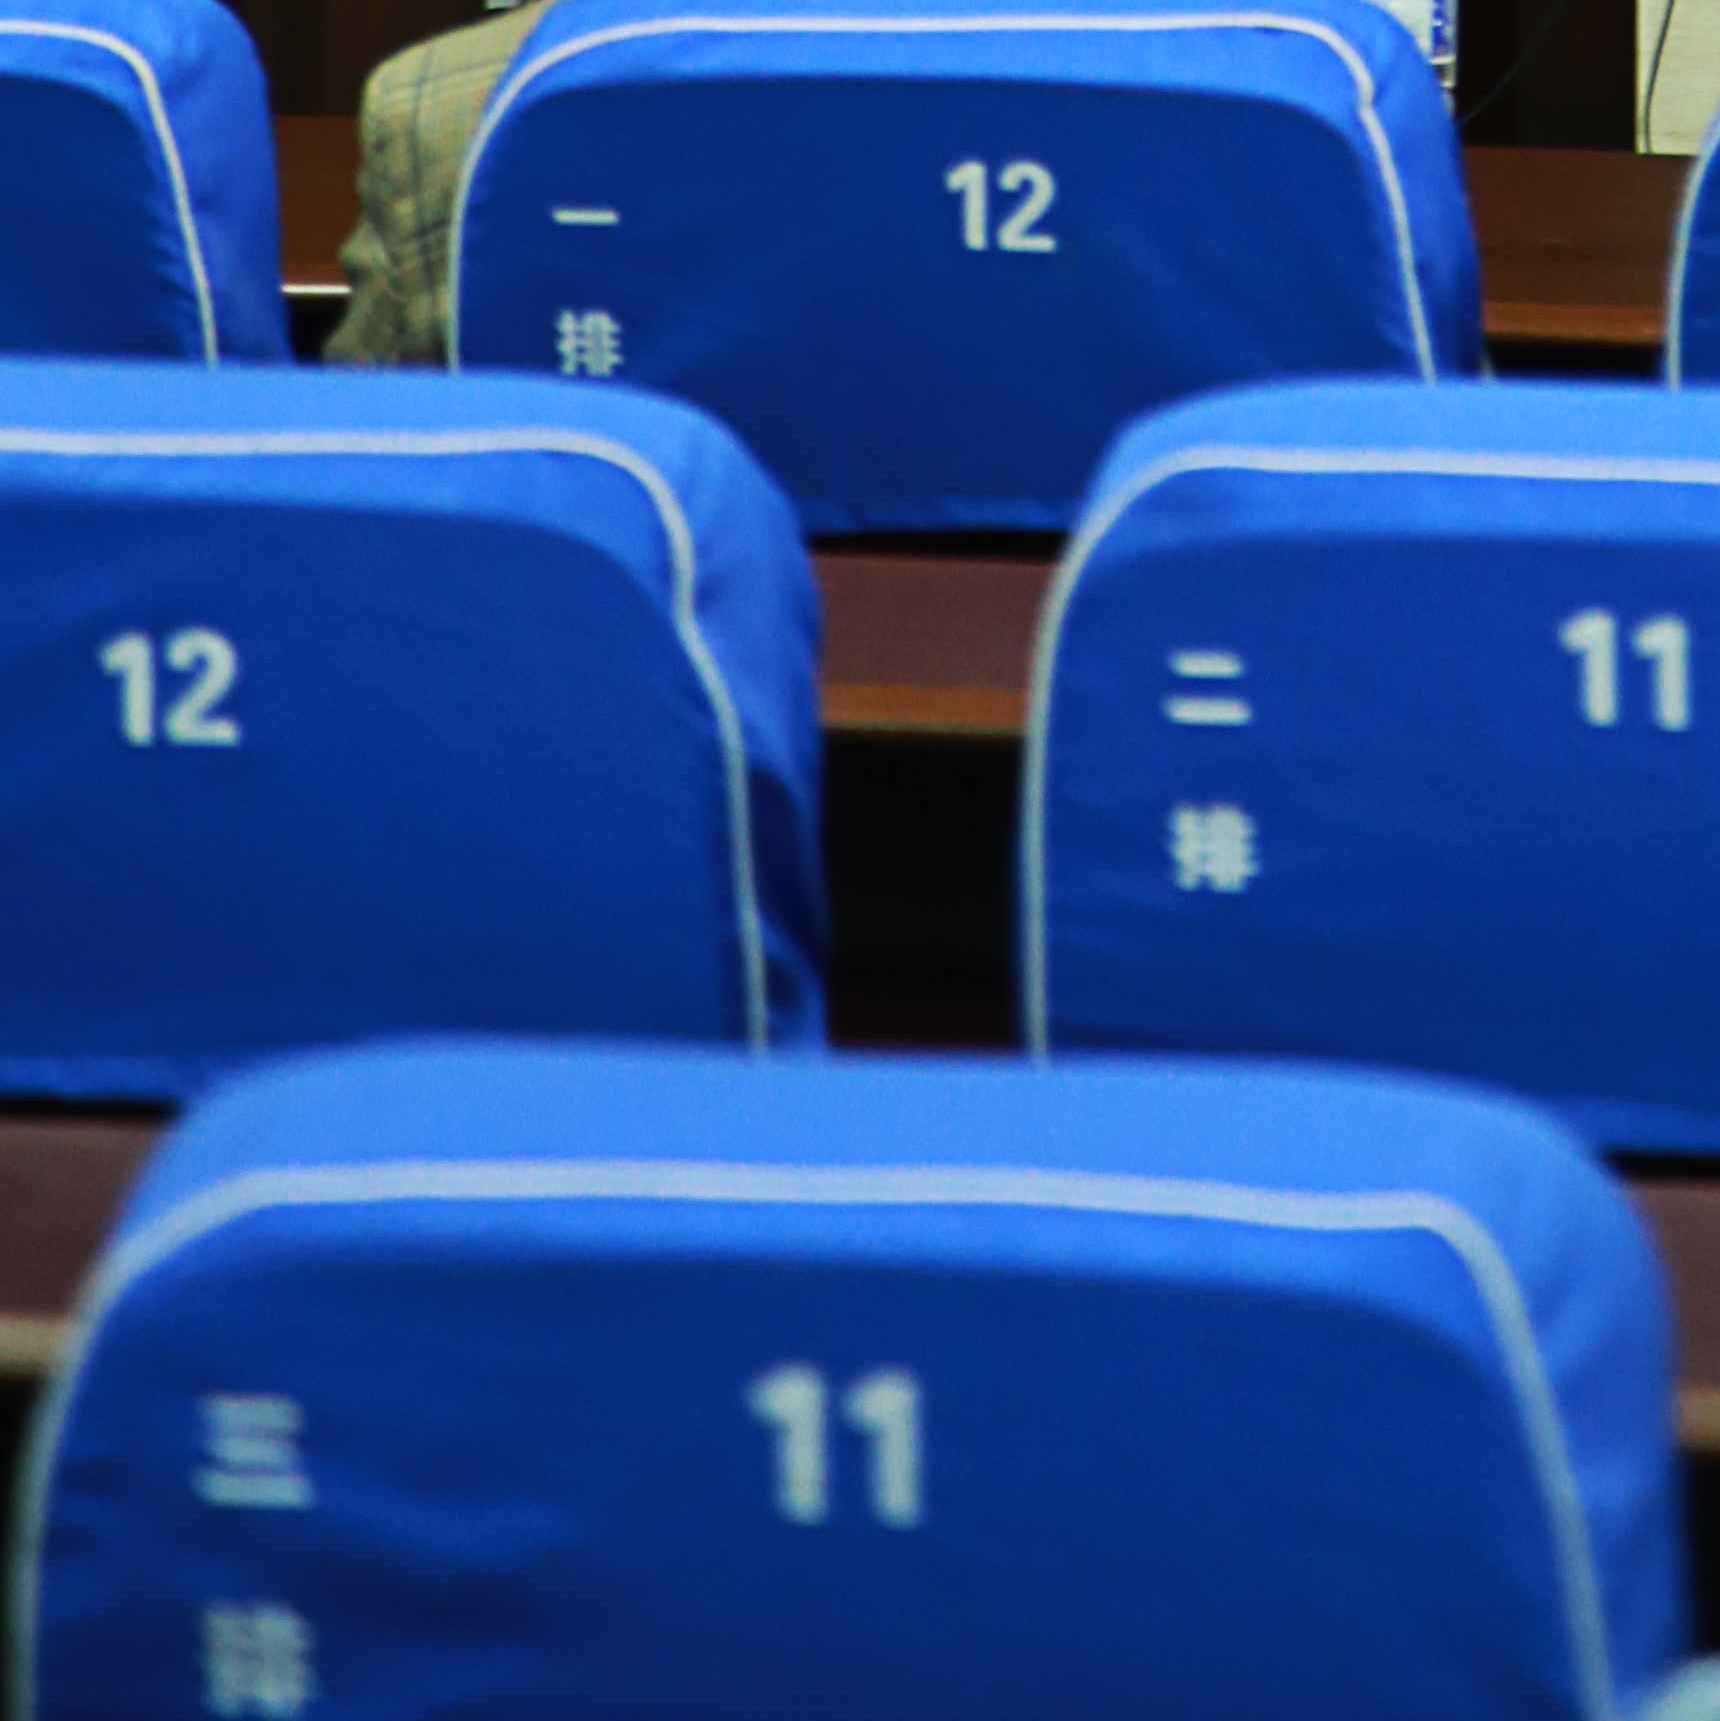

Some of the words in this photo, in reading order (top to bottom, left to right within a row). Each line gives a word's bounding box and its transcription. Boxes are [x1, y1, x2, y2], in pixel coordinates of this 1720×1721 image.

[945, 159, 1057, 253] 12
[101, 627, 241, 745] 12
[1560, 609, 1690, 729] 11
[752, 1365, 922, 1521] 11
